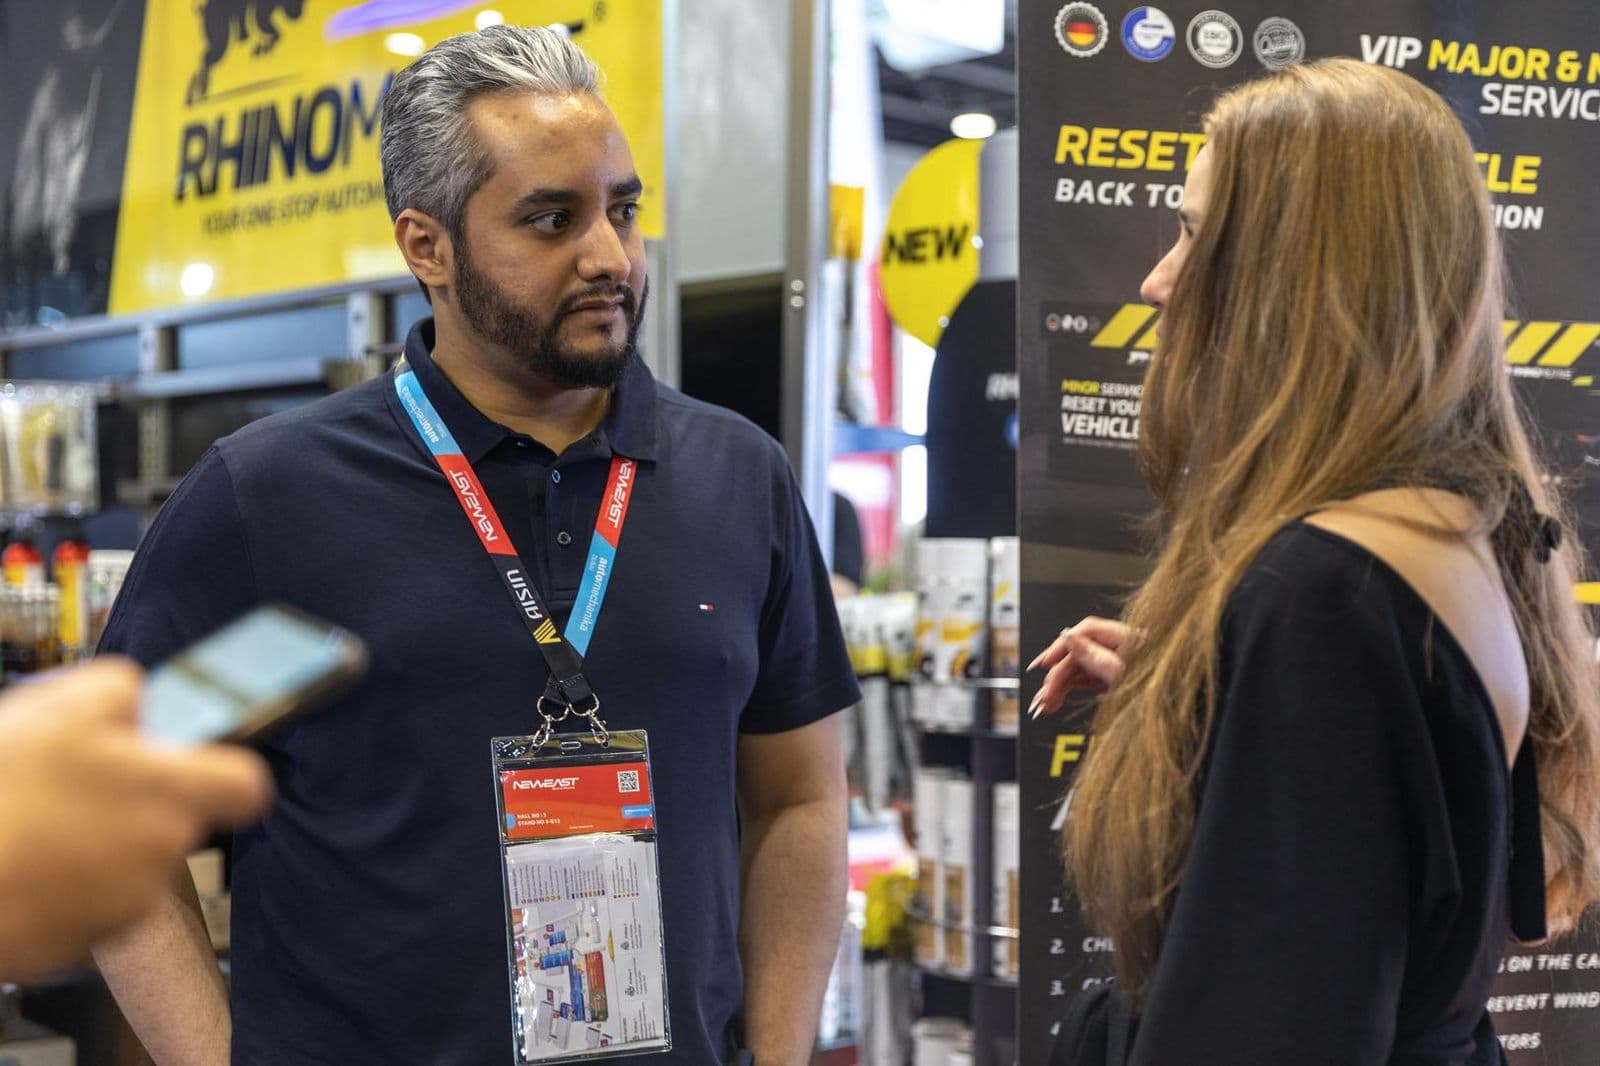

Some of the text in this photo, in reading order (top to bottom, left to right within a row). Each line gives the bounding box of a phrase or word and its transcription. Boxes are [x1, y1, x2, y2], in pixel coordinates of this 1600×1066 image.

[1359, 34, 1422, 68] VIP
[1427, 39, 1550, 80] MAJOR
[1556, 51, 1582, 83] &
[1479, 83, 1600, 121] SERVIC
[1055, 125, 1209, 172] RESET
[1055, 179, 1186, 209] BACK TO
[1490, 204, 1544, 230] ION
[882, 224, 969, 268] NEW
[1062, 395, 1106, 413] RESET
[449, 469, 498, 542] NEWEAST
[608, 459, 632, 529] NEWEAST
[506, 569, 543, 620] AISIN
[579, 557, 608, 632] automechanika
[512, 777, 579, 790] NEWEAST
[1507, 955, 1533, 973] ON
[1536, 953, 1573, 971] THE
